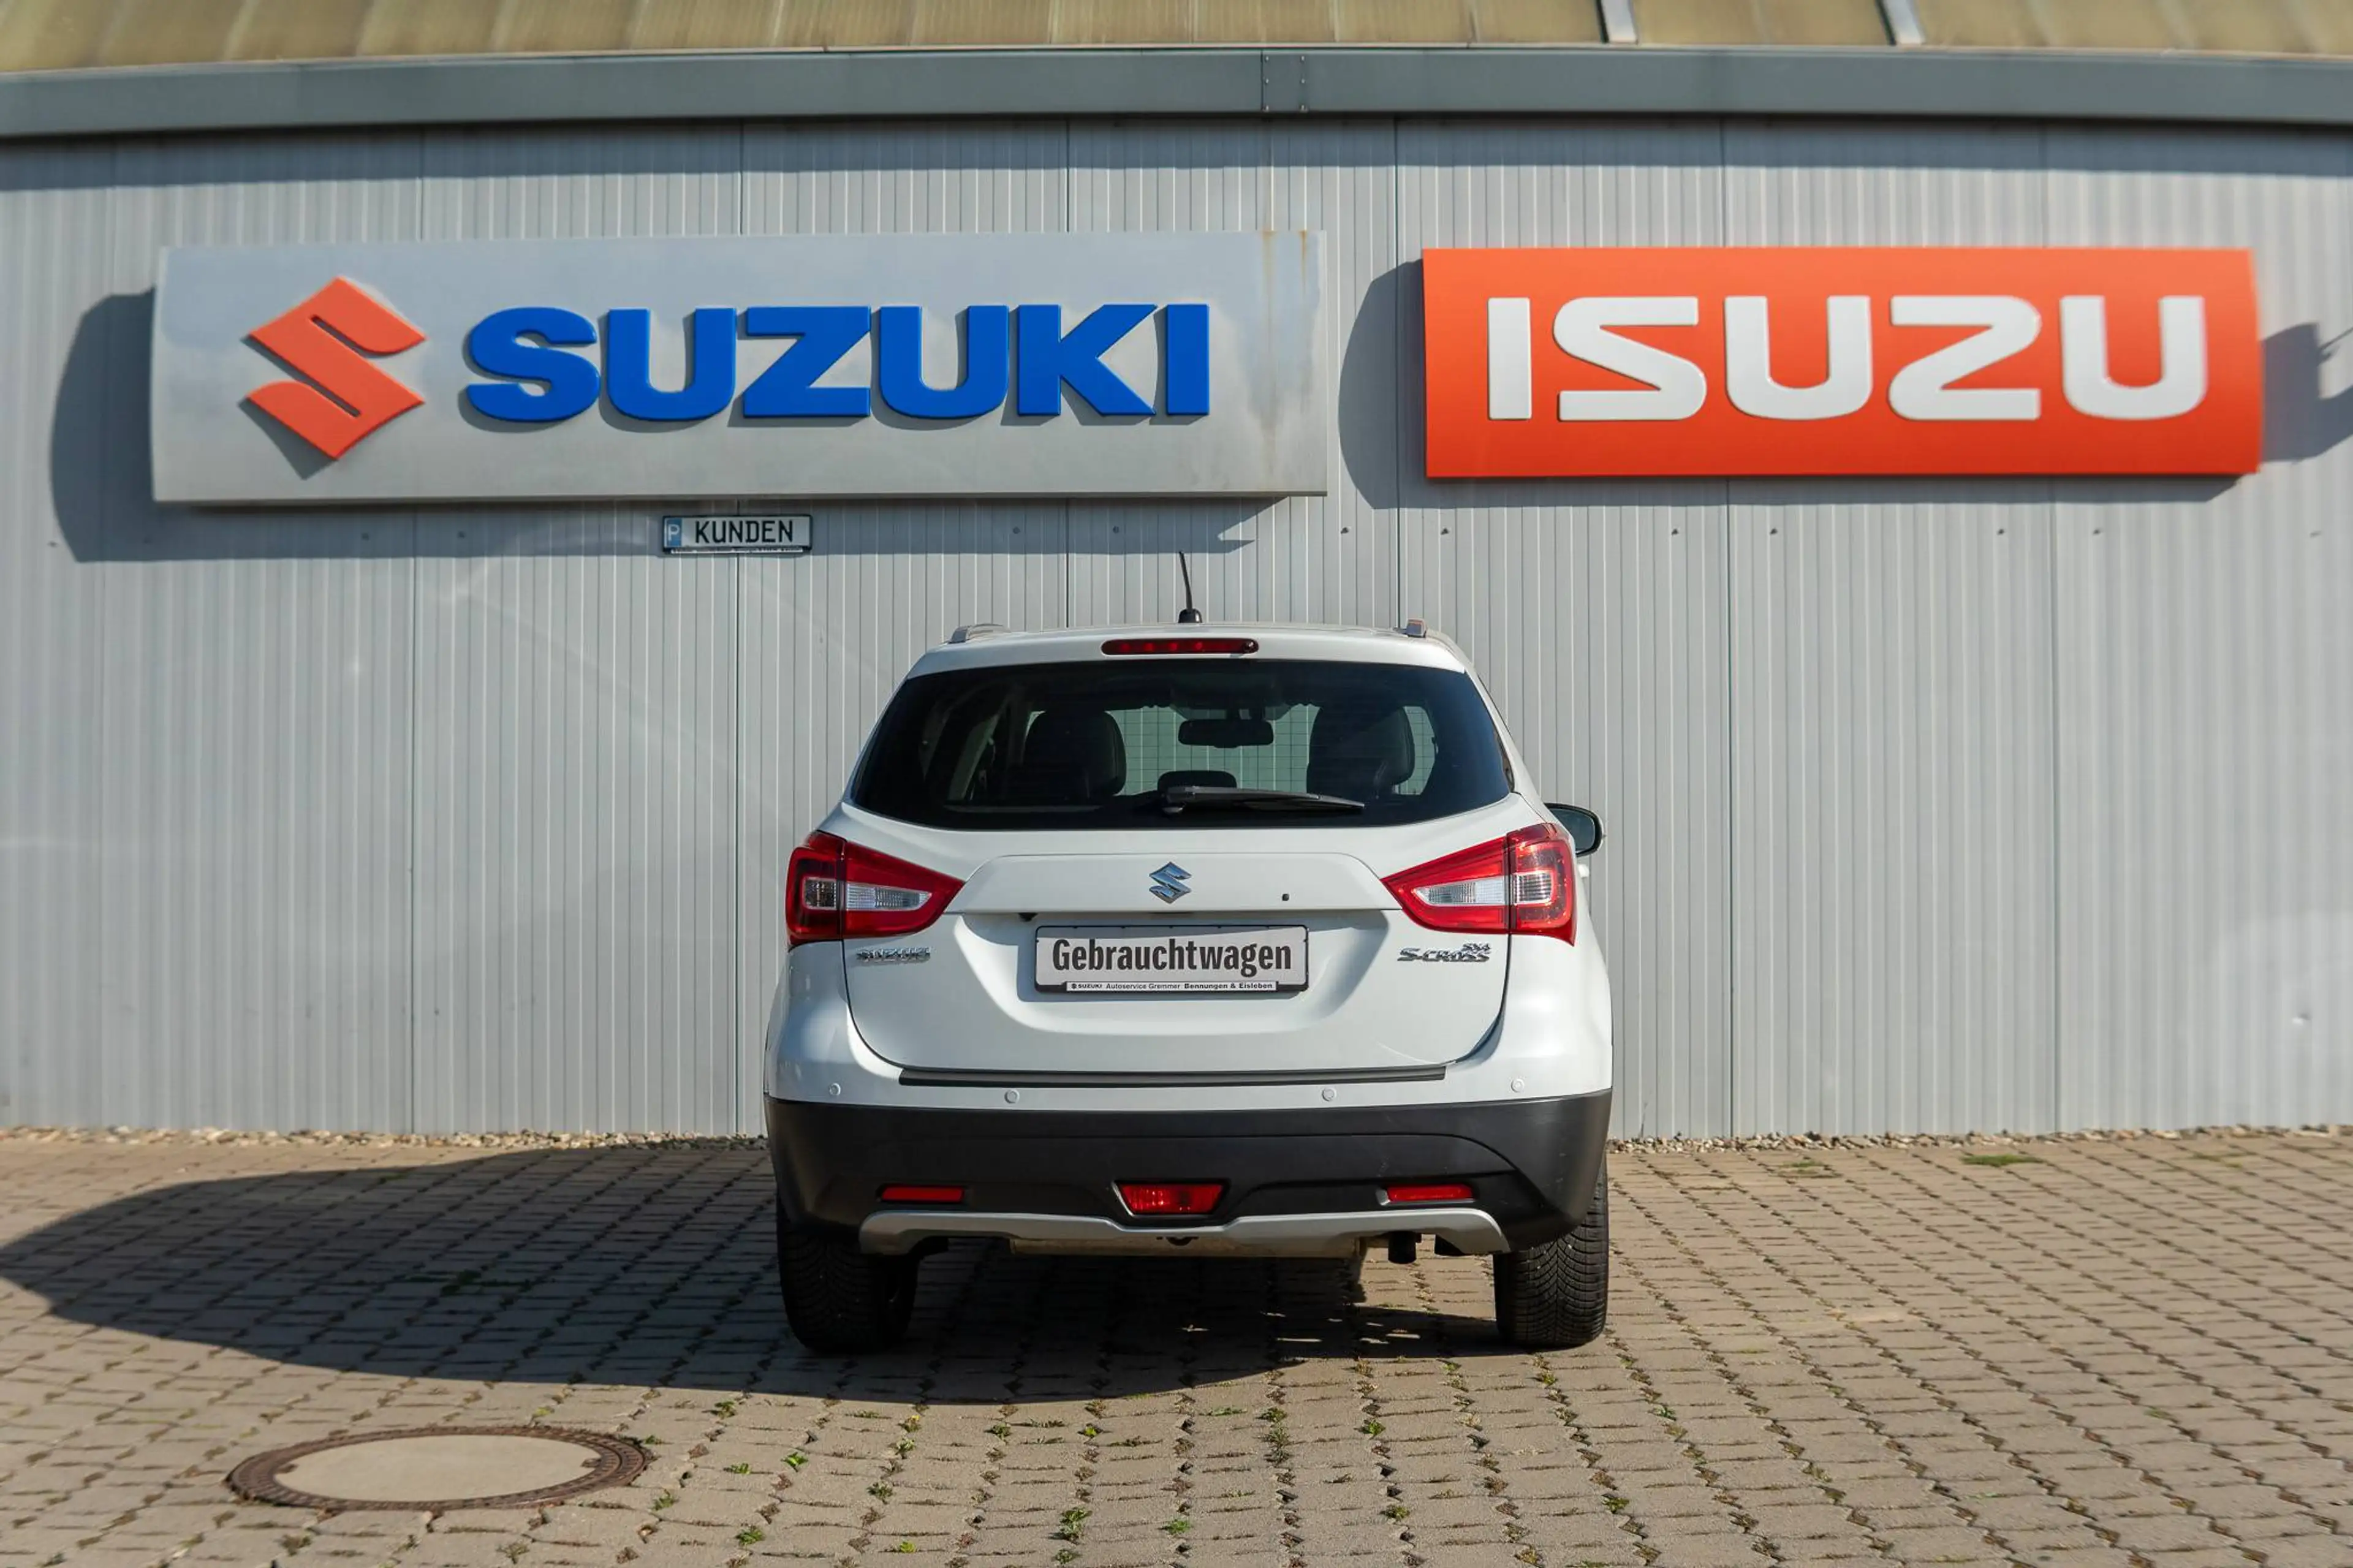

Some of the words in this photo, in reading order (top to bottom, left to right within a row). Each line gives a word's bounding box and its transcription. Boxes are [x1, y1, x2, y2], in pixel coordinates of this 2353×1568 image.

[466, 304, 1210, 423] SUZUKI
[1487, 296, 2205, 420] ISUZU
[667, 524, 680, 541] P
[695, 520, 793, 543] KUNDEN
[1052, 938, 1292, 978] Gebrauchtwagen
